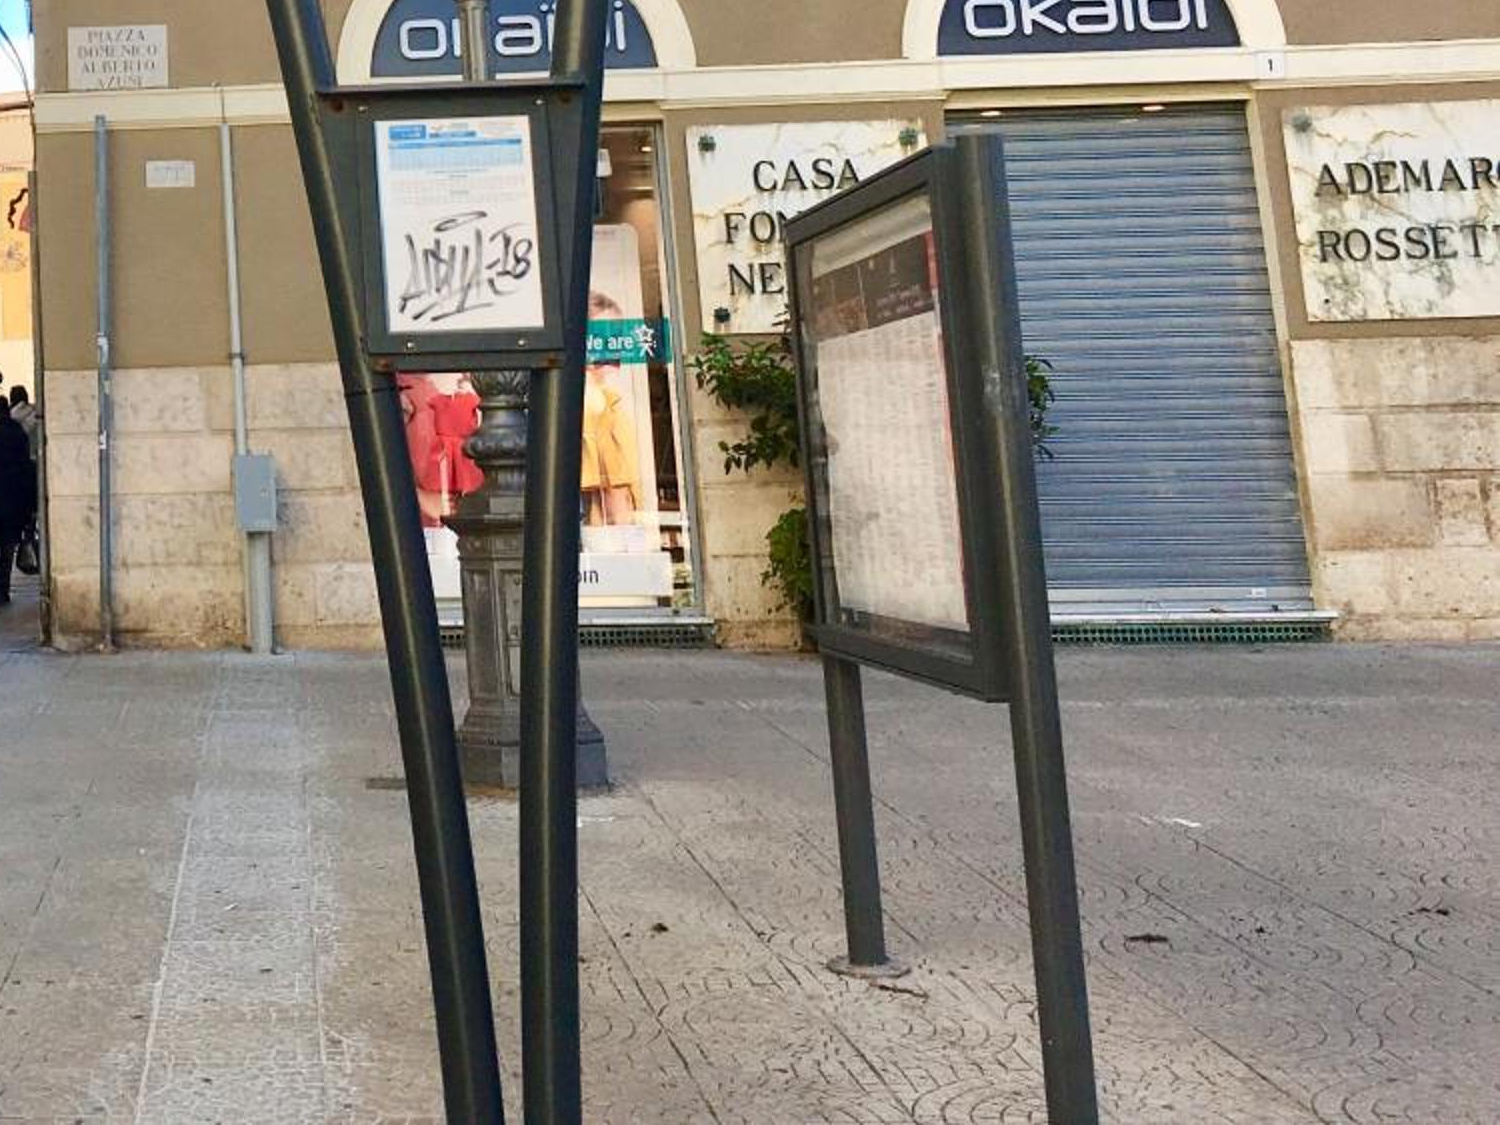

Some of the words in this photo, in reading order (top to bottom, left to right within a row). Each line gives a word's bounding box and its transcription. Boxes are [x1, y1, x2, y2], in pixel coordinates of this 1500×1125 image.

[86, 28, 145, 43] PIAZZA
[77, 44, 157, 59] DOMENICO
[81, 60, 156, 74] ALBERTO
[752, 158, 862, 192] CASA
[1314, 156, 1500, 197] ADEMAR
[607, 335, 634, 350] are
